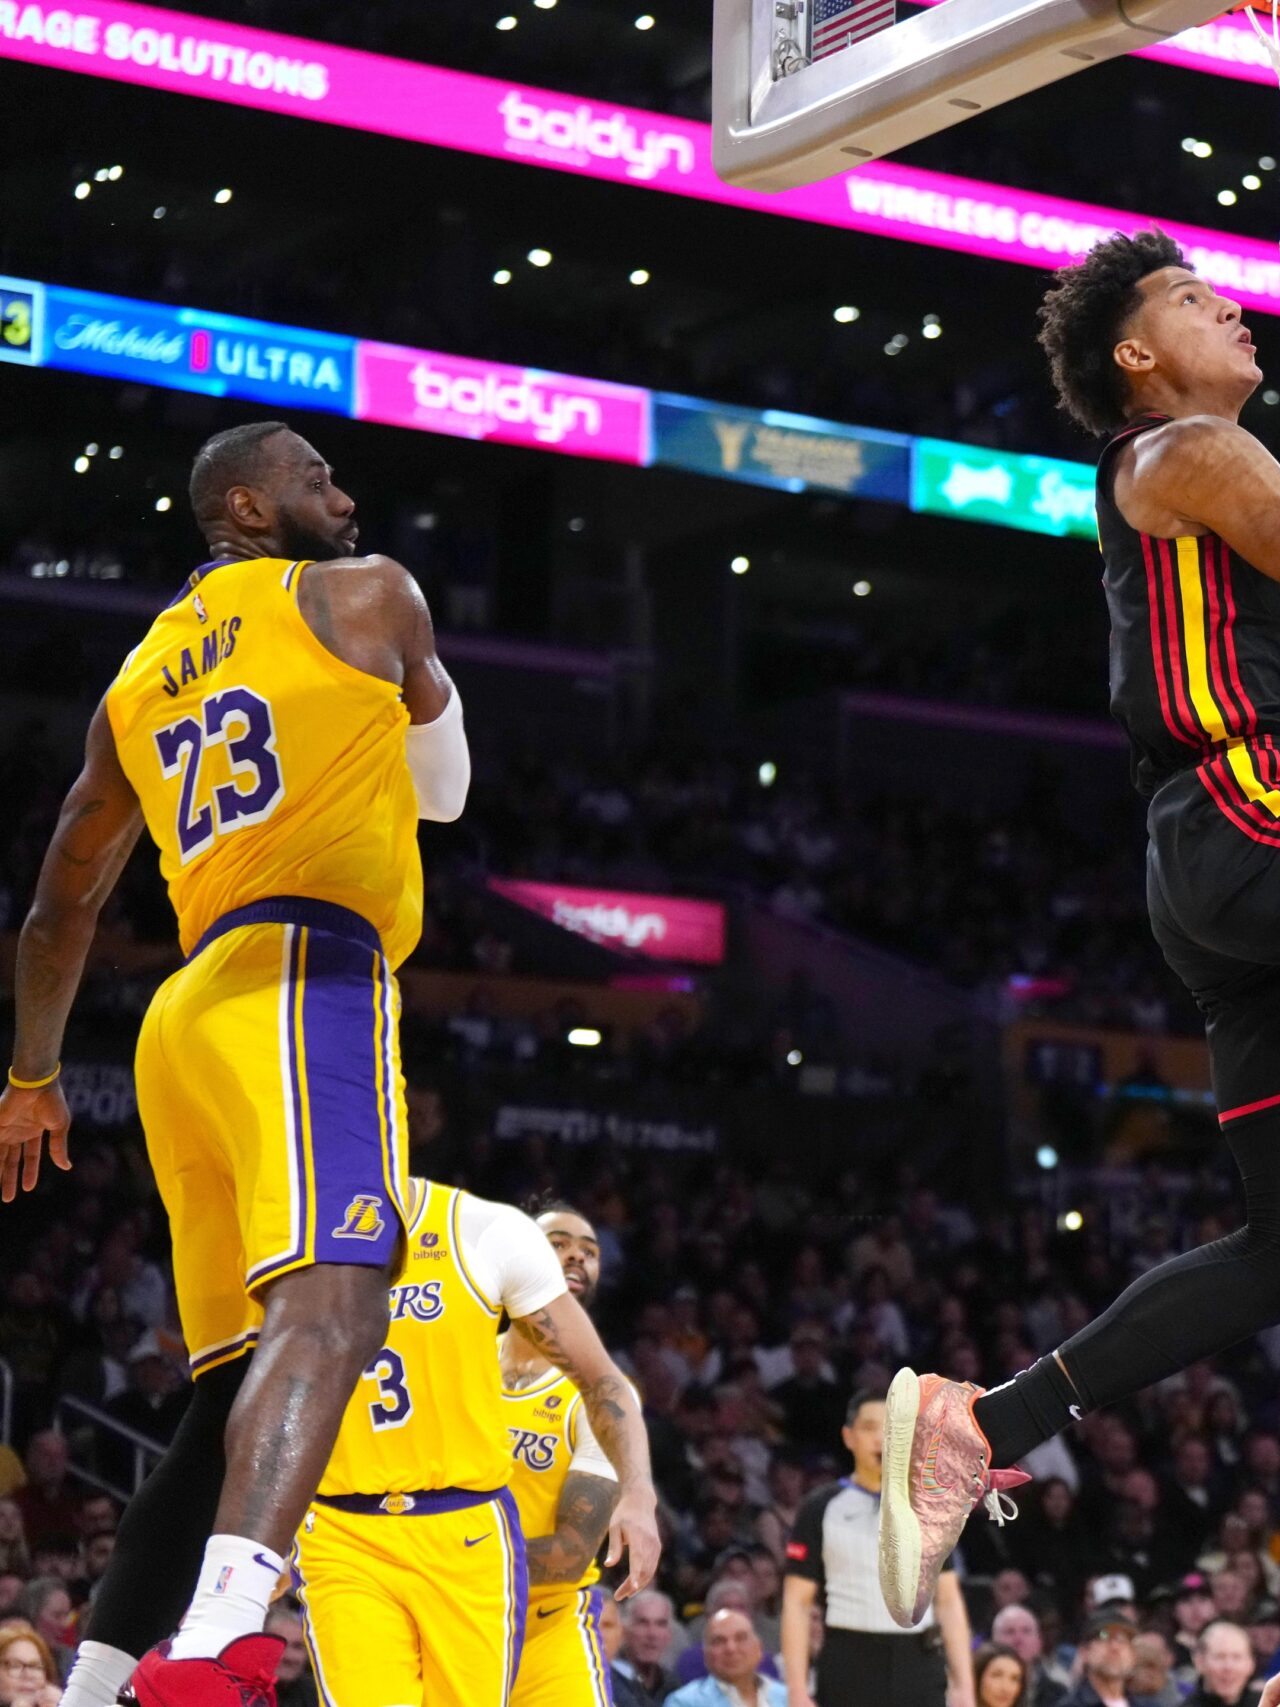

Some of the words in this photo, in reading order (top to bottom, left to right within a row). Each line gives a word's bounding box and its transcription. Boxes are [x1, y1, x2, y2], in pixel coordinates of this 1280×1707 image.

[103, 22, 330, 101] SOLUTIONS
[499, 90, 695, 180] boldyn
[846, 175, 1019, 244] WIRELESS
[216, 338, 343, 393] ULTRA
[408, 363, 600, 443] boldyn
[161, 616, 242, 698] JAMES
[153, 685, 286, 867] 23
[413, 1249, 448, 1262] bibigo
[362, 1348, 414, 1433] 3
[532, 1407, 562, 1424] bibigo
